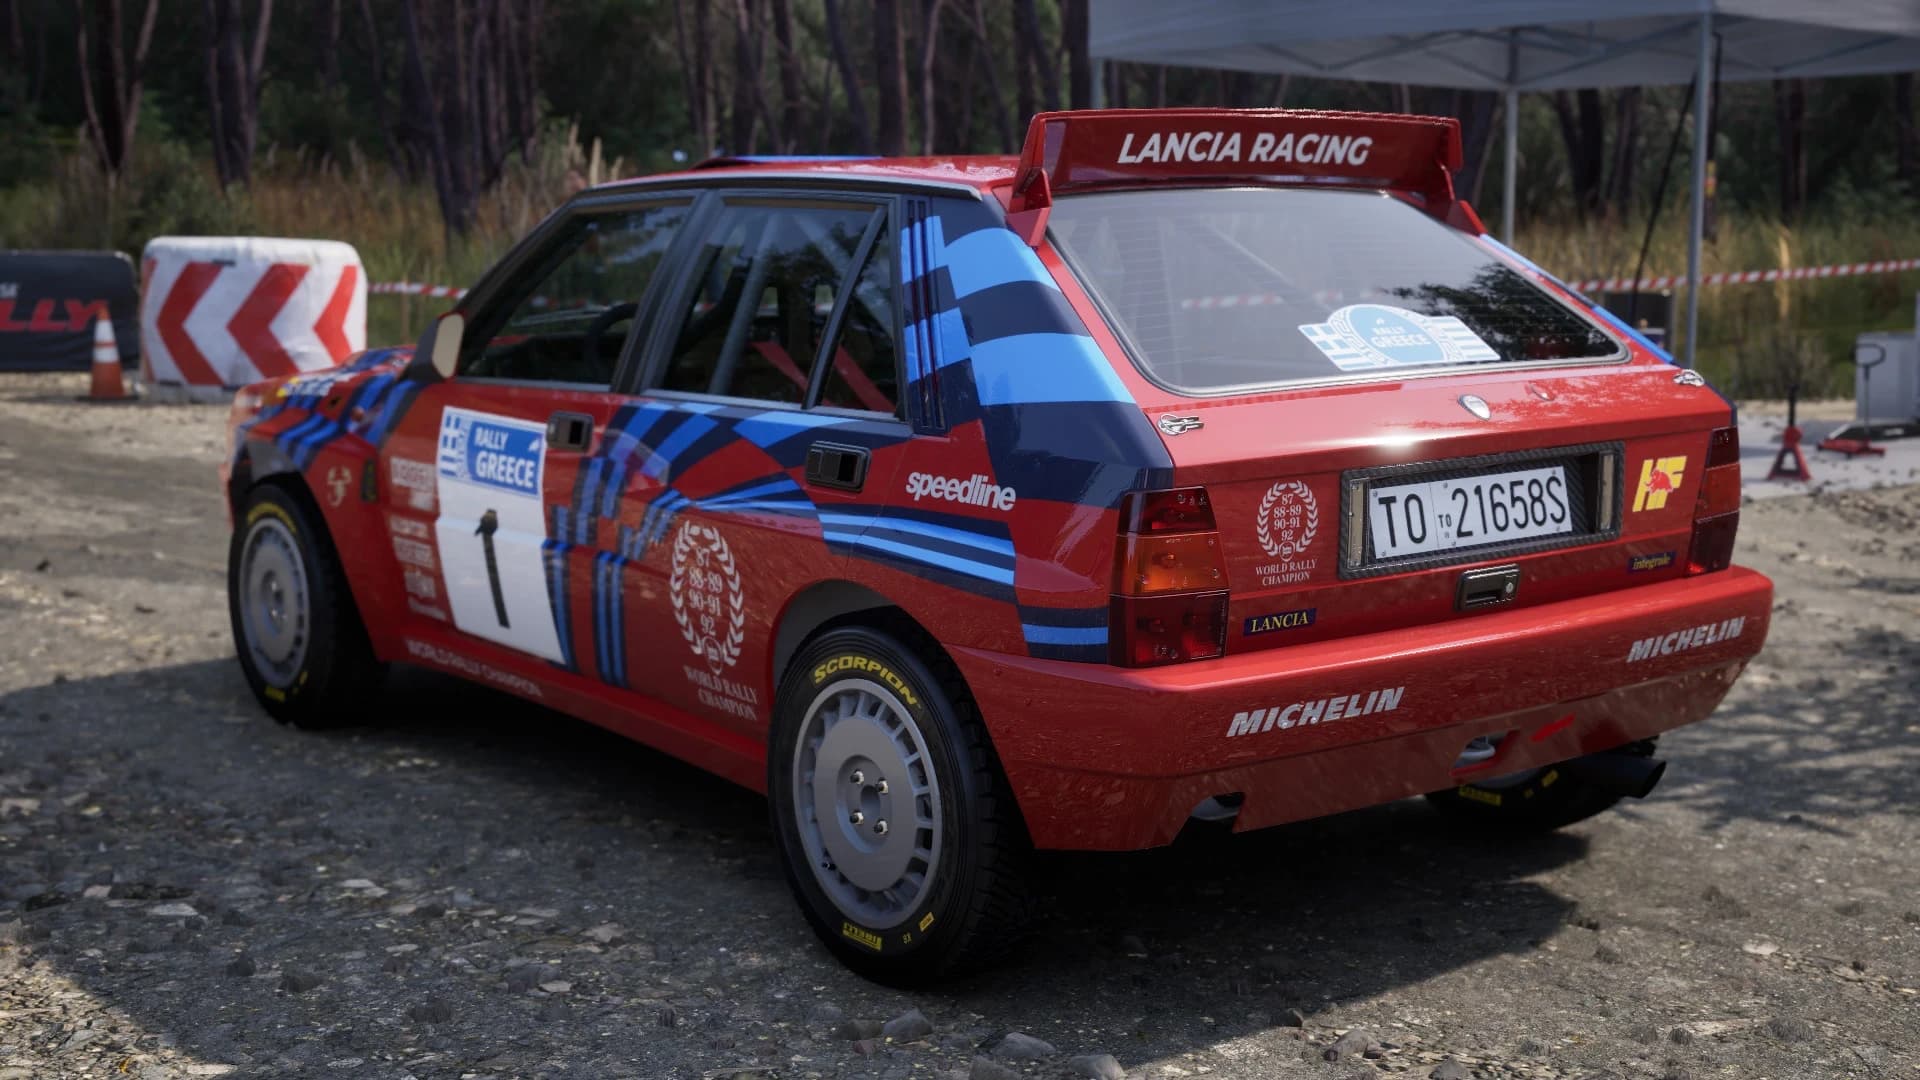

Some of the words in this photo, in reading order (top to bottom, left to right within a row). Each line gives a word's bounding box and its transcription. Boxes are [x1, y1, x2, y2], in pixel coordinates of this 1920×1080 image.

[1117, 132, 1241, 163] LANCIA
[1248, 133, 1373, 166] RACING
[474, 427, 509, 451] RALLY
[476, 450, 535, 489] GREECE
[905, 471, 1017, 511] speedline
[1282, 493, 1294, 505] 87
[1273, 504, 1302, 519] 88-89
[1451, 475, 1567, 538] 21658S
[1274, 517, 1301, 530] 90-91
[1378, 493, 1427, 548] TO
[1281, 529, 1294, 541] 92
[474, 507, 511, 630] 1
[696, 546, 710, 568] 87
[1255, 563, 1288, 576] WORLD
[1289, 558, 1318, 572] RALLY
[1262, 570, 1311, 586] CHAMPION
[700, 613, 717, 637] 92
[1250, 611, 1309, 634] LANCIA
[1626, 616, 1746, 663] MICHELIN
[814, 655, 918, 705] SCORPION
[1226, 686, 1405, 738] MICHELIN
